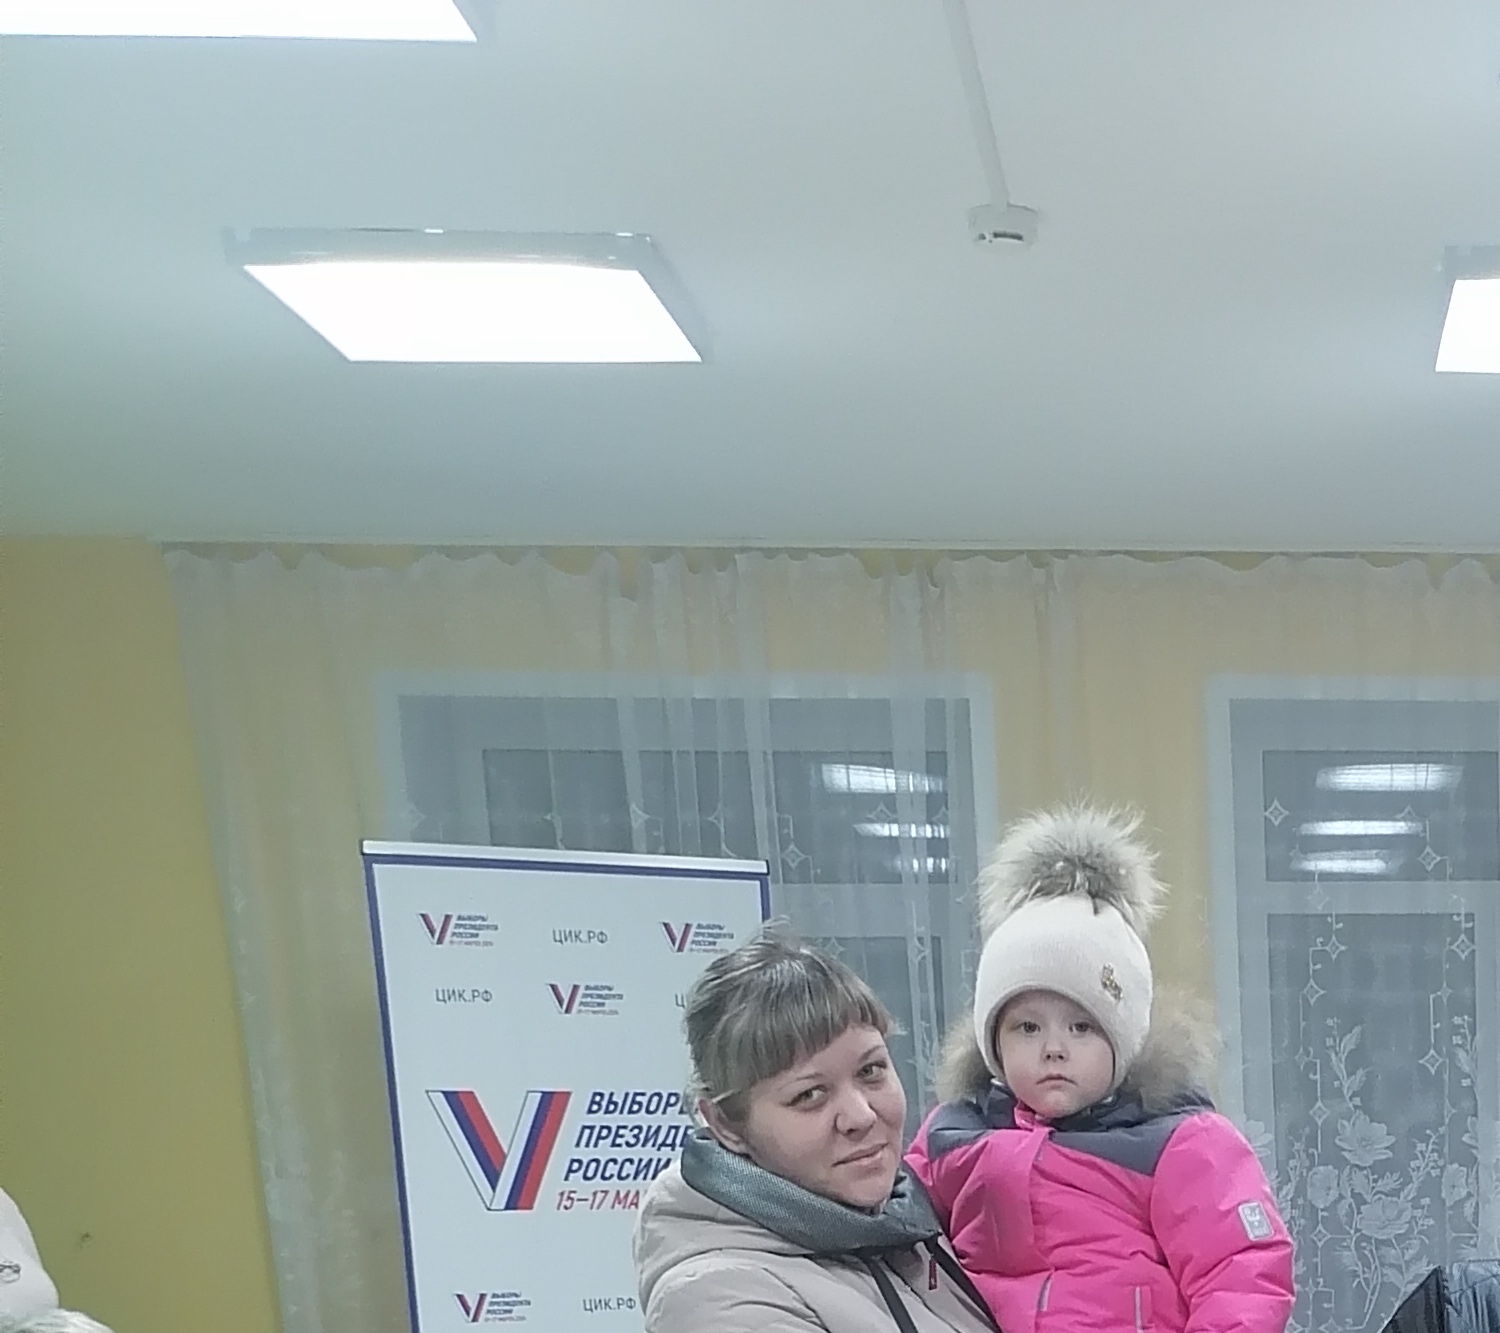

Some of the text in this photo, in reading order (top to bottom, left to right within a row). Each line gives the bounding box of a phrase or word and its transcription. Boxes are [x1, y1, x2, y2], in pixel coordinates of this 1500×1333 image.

[552, 928, 608, 945] ЦИК.РФ
[435, 988, 493, 1004] ЦИК.РФ
[583, 1297, 636, 1313] ЦИК.РФ
